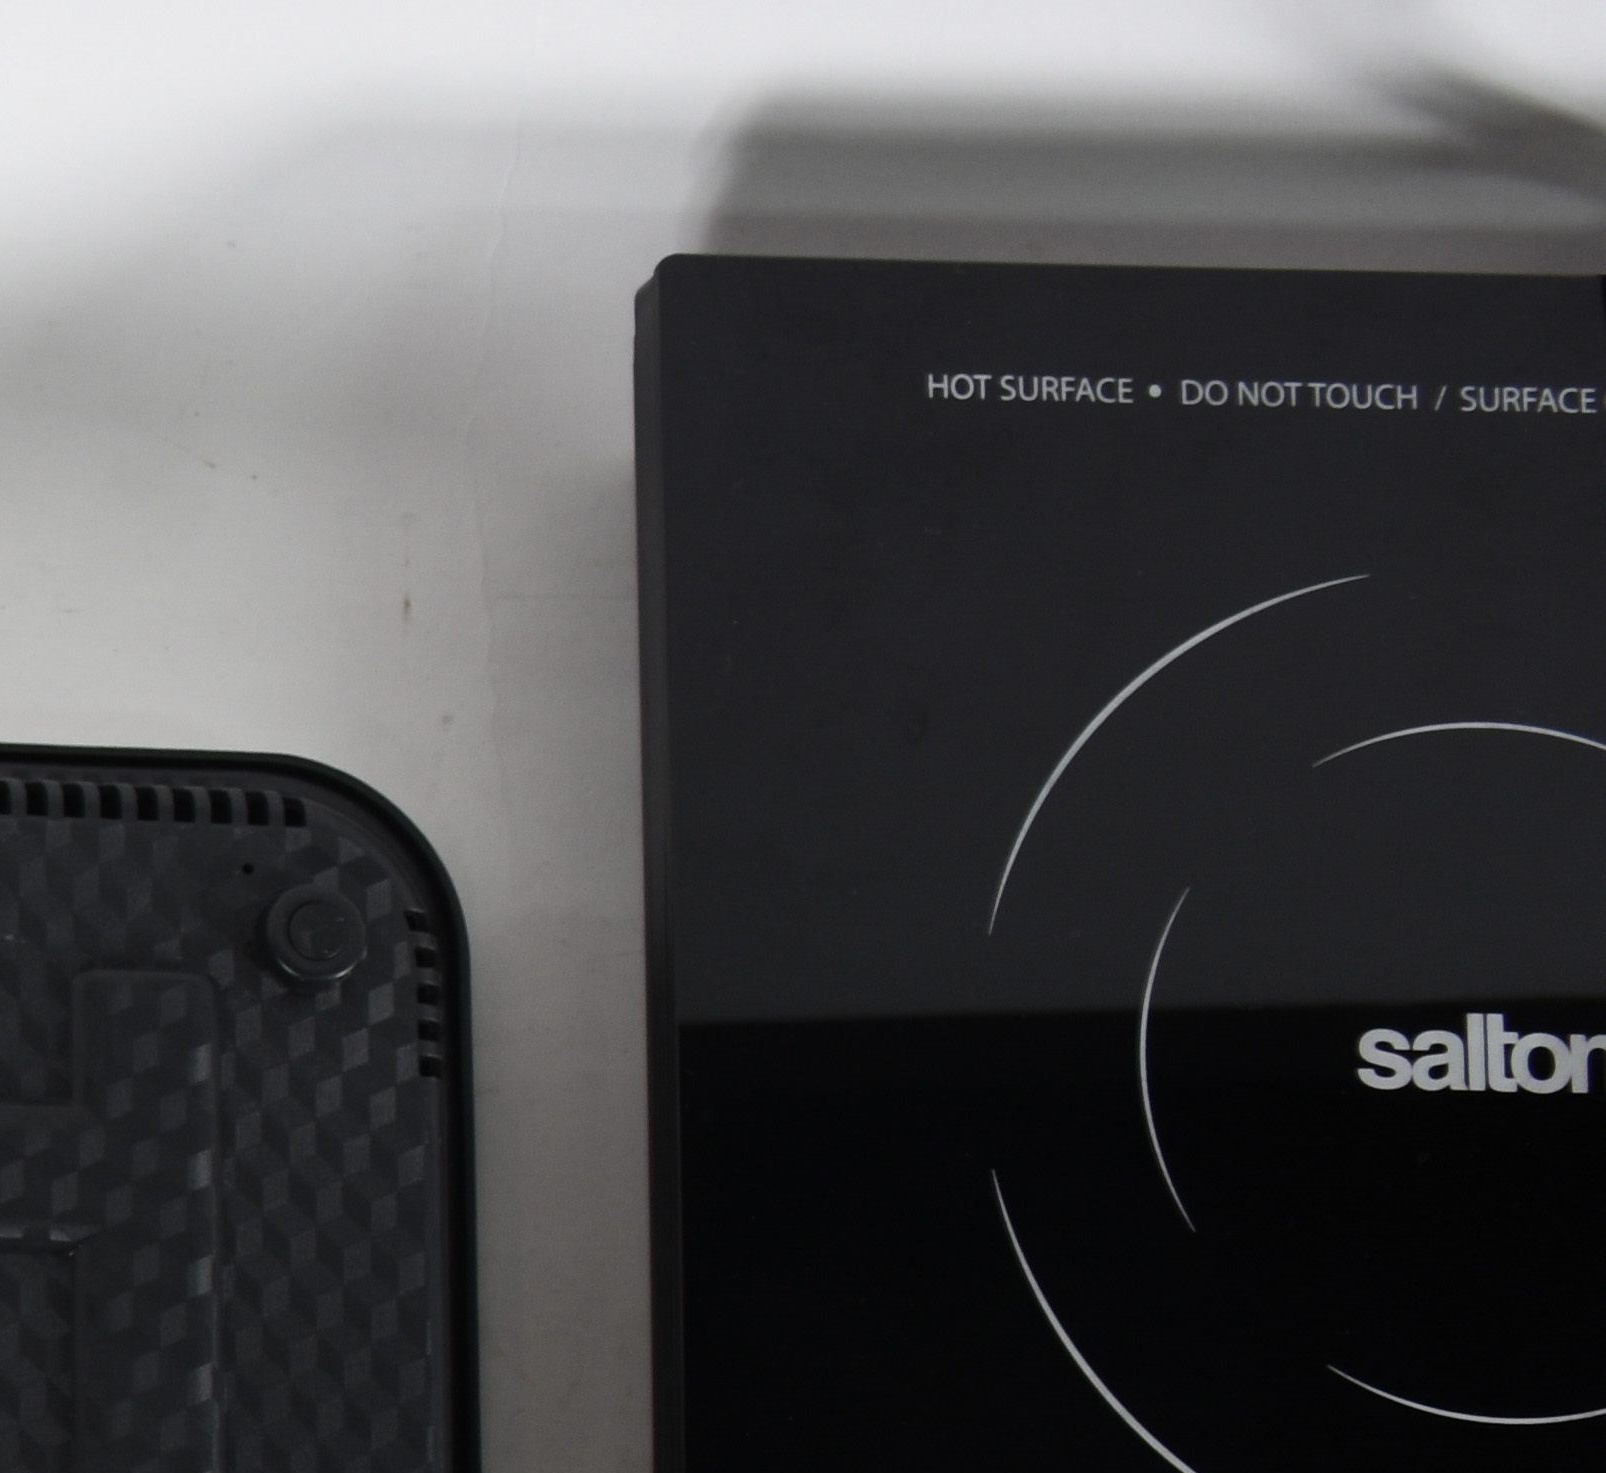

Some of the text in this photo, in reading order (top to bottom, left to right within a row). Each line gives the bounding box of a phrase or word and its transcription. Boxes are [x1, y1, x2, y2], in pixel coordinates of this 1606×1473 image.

[927, 373, 1597, 413] HOT SURFACE DO NOT TOUCH / SURFACE
